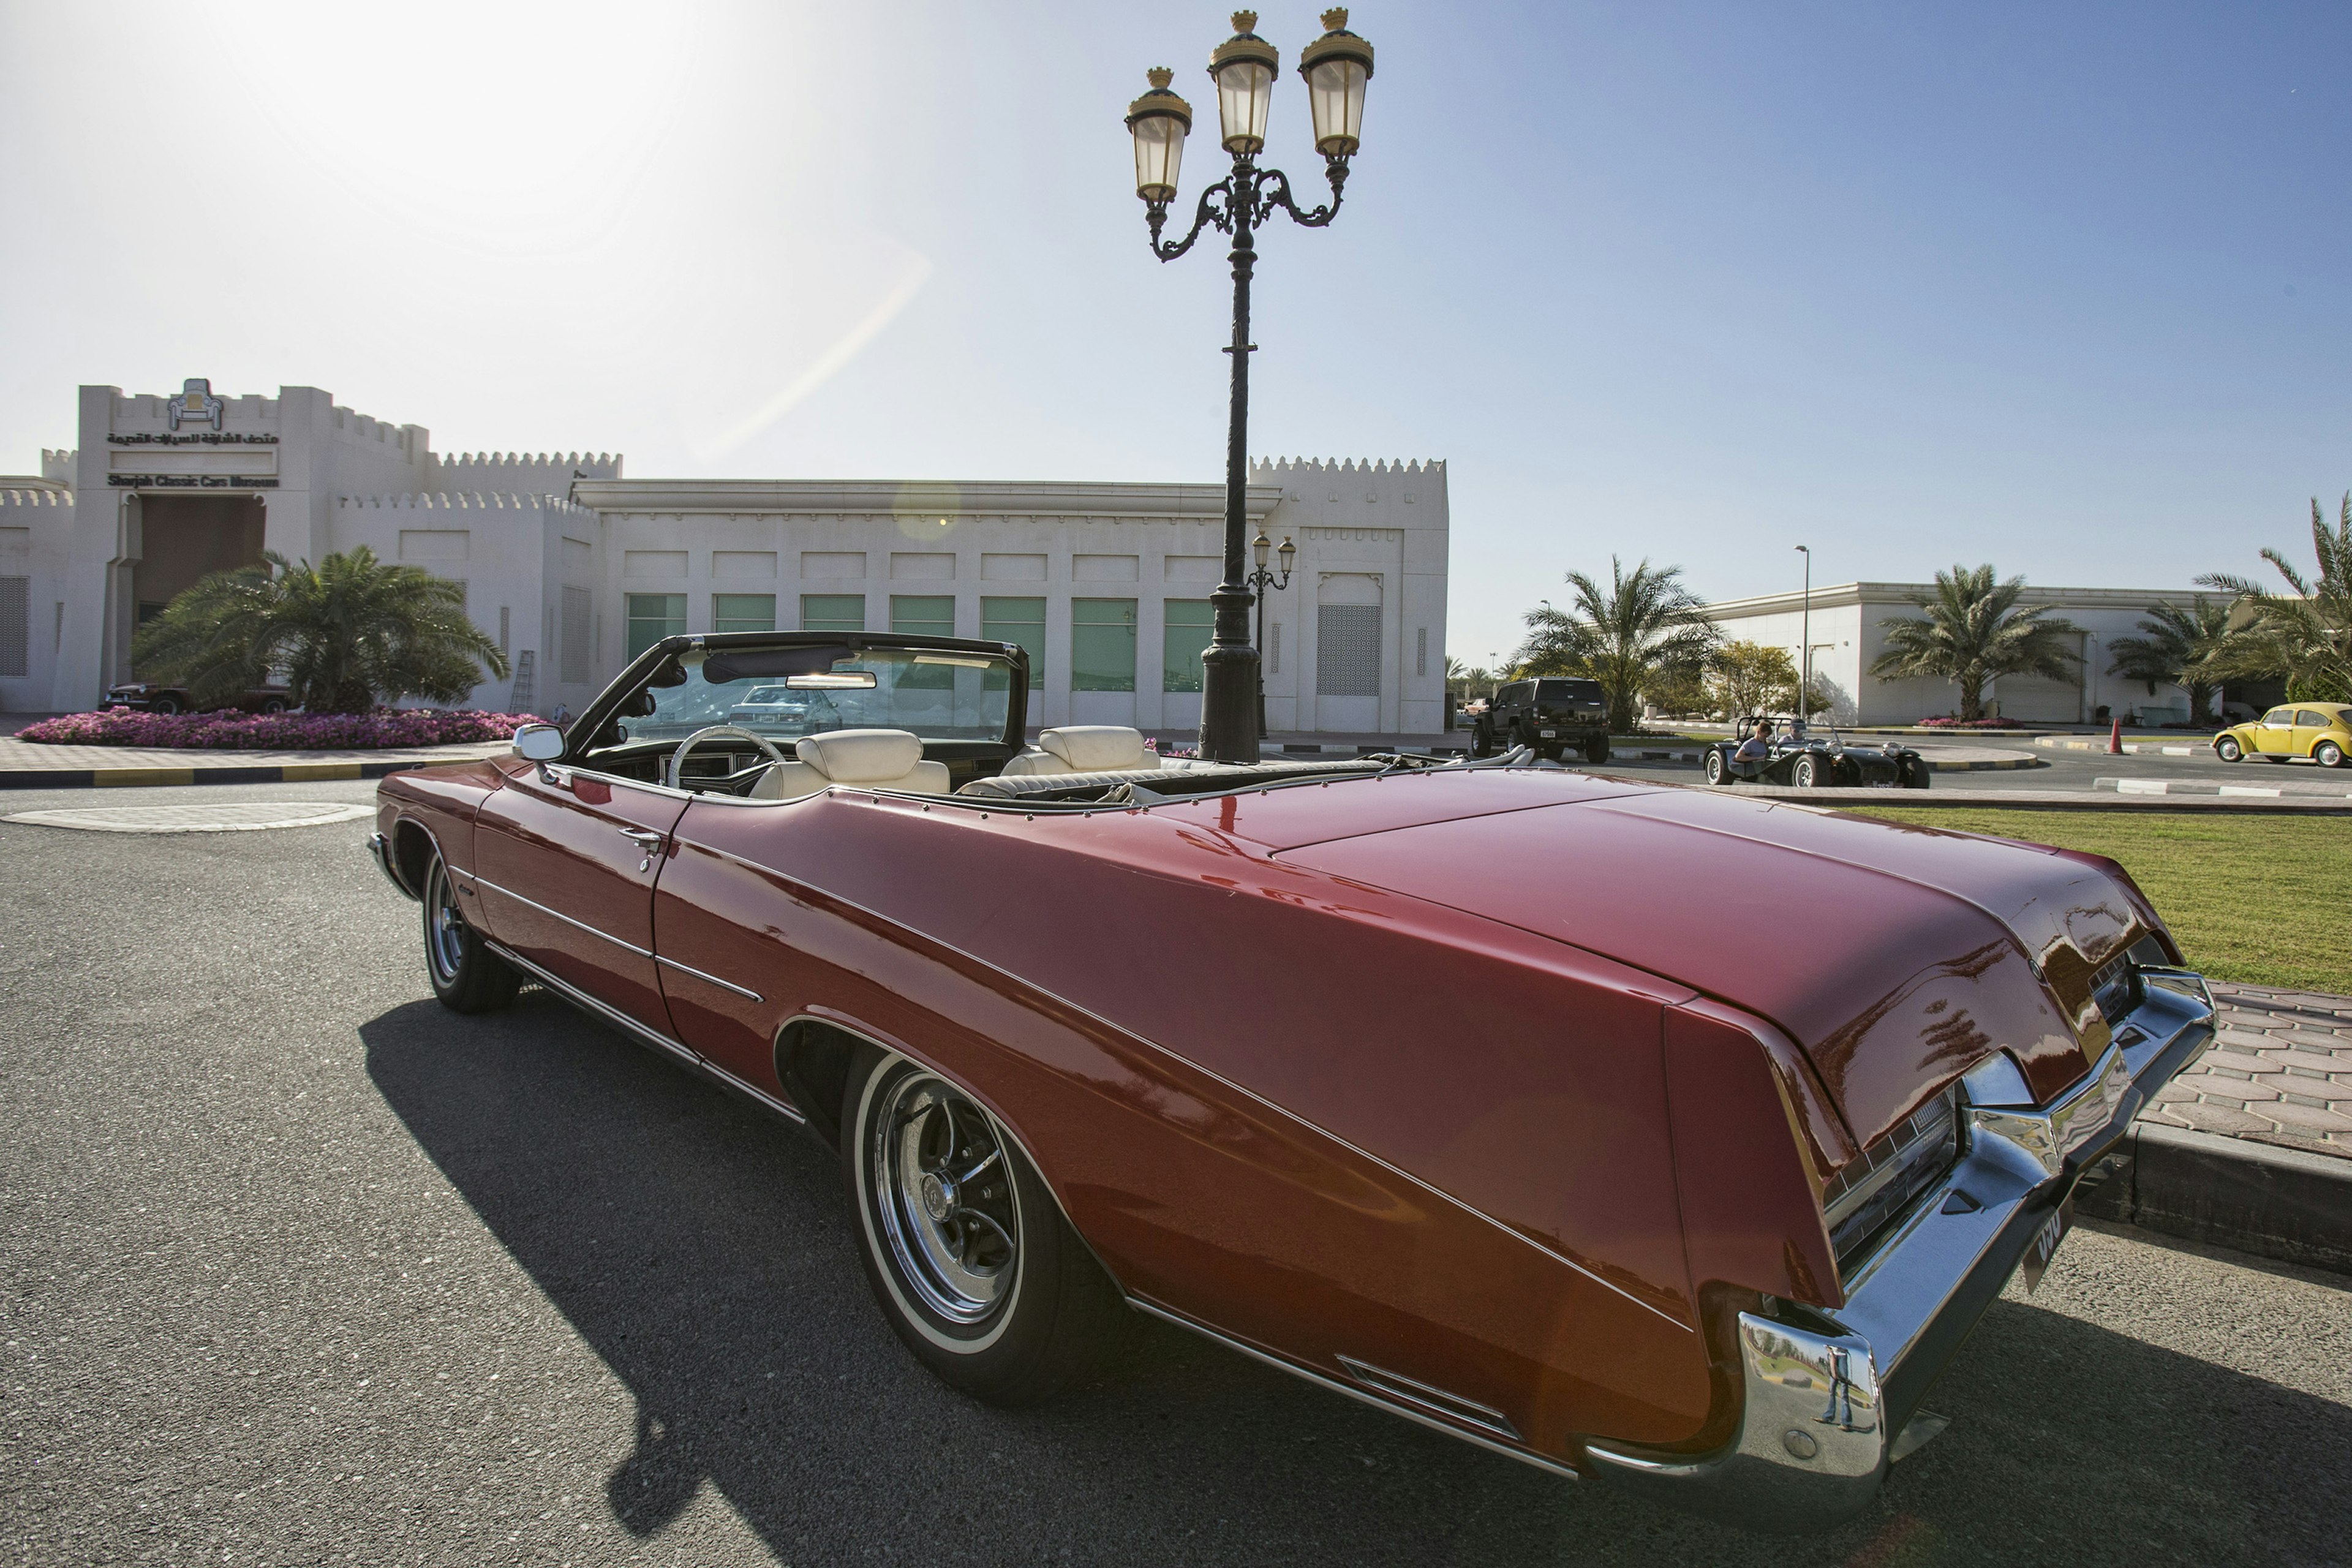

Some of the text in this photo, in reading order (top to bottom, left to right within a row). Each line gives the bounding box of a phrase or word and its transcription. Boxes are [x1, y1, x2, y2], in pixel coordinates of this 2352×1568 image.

[108, 432, 279, 445] متحف الشارقة للسيارات القديمة
[108, 475, 279, 489] Sharjah Classic Cars Museum
